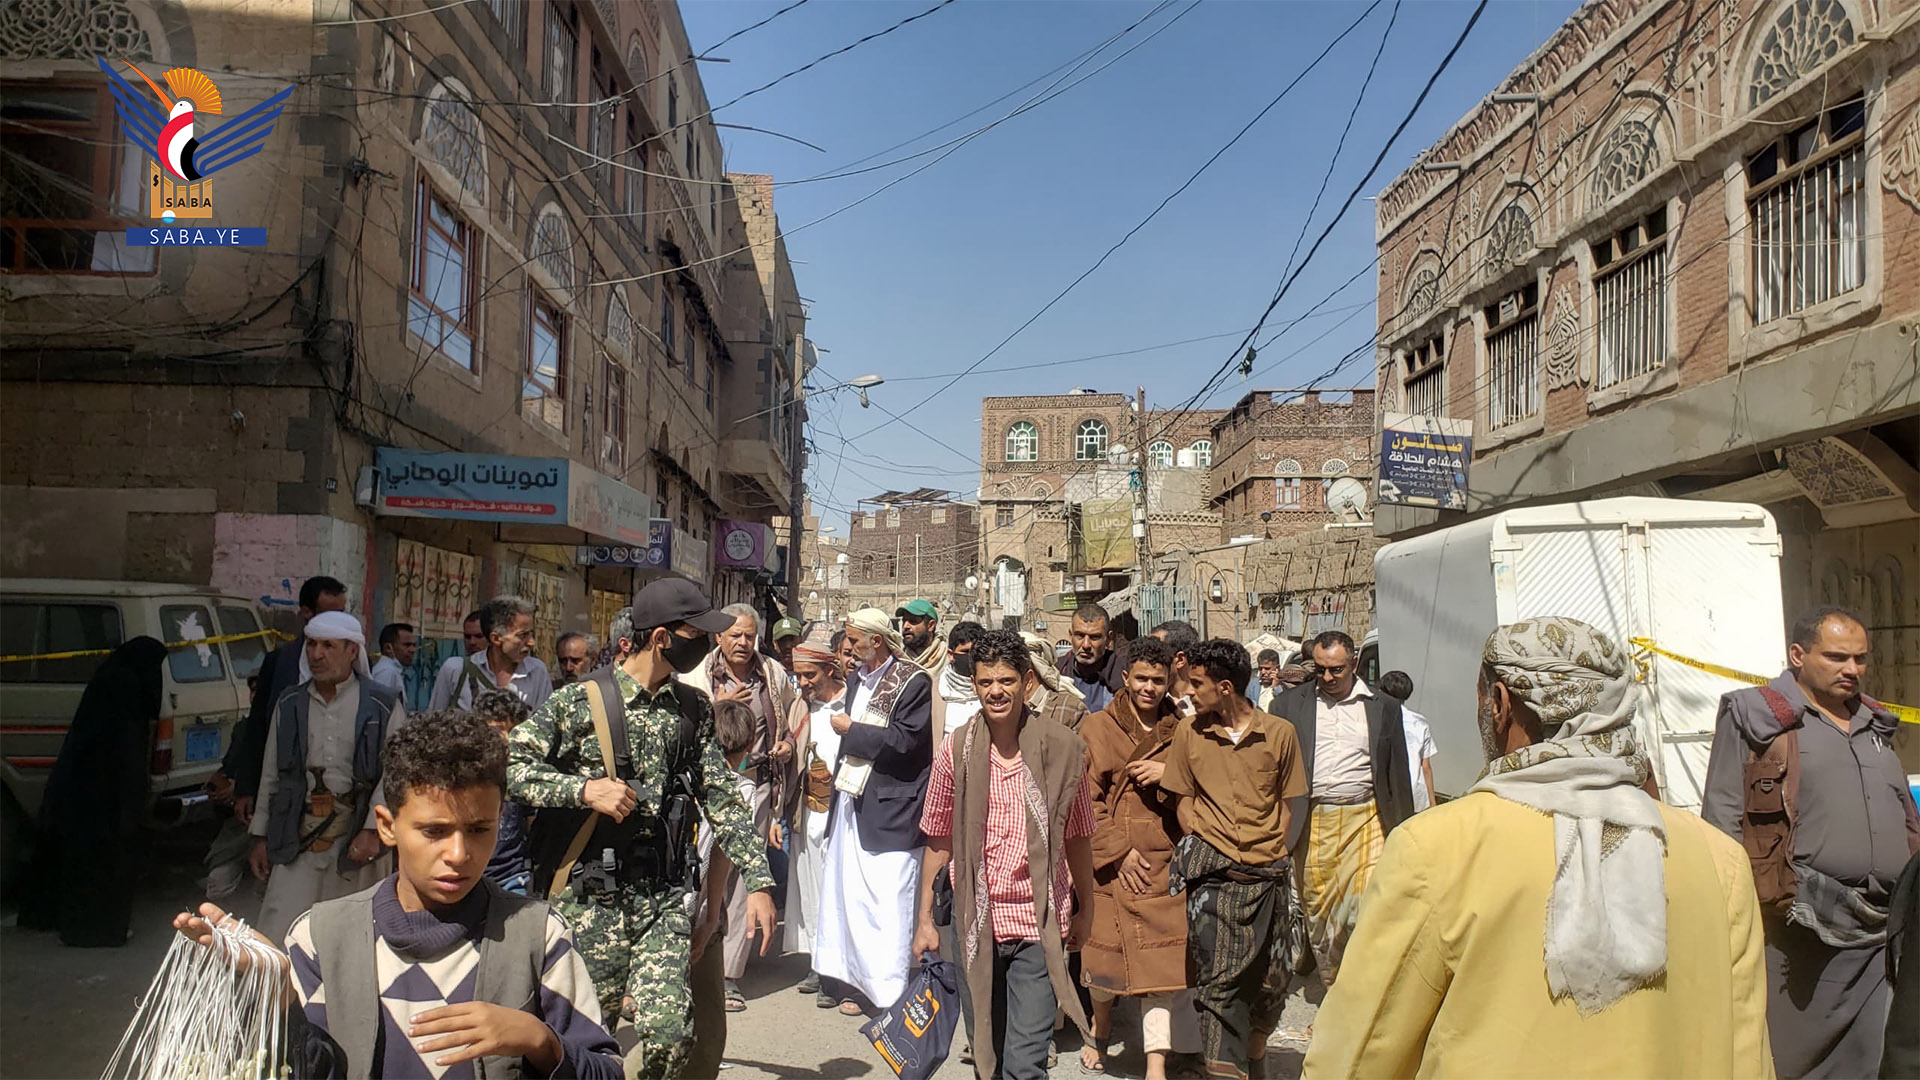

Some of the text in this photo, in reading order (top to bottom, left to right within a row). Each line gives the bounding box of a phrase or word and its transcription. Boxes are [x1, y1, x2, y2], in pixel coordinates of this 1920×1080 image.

[1391, 433, 1463, 453] صالون
[1388, 450, 1462, 468] هشام للحلاقة
[385, 461, 558, 491] تموينات الوصابي
